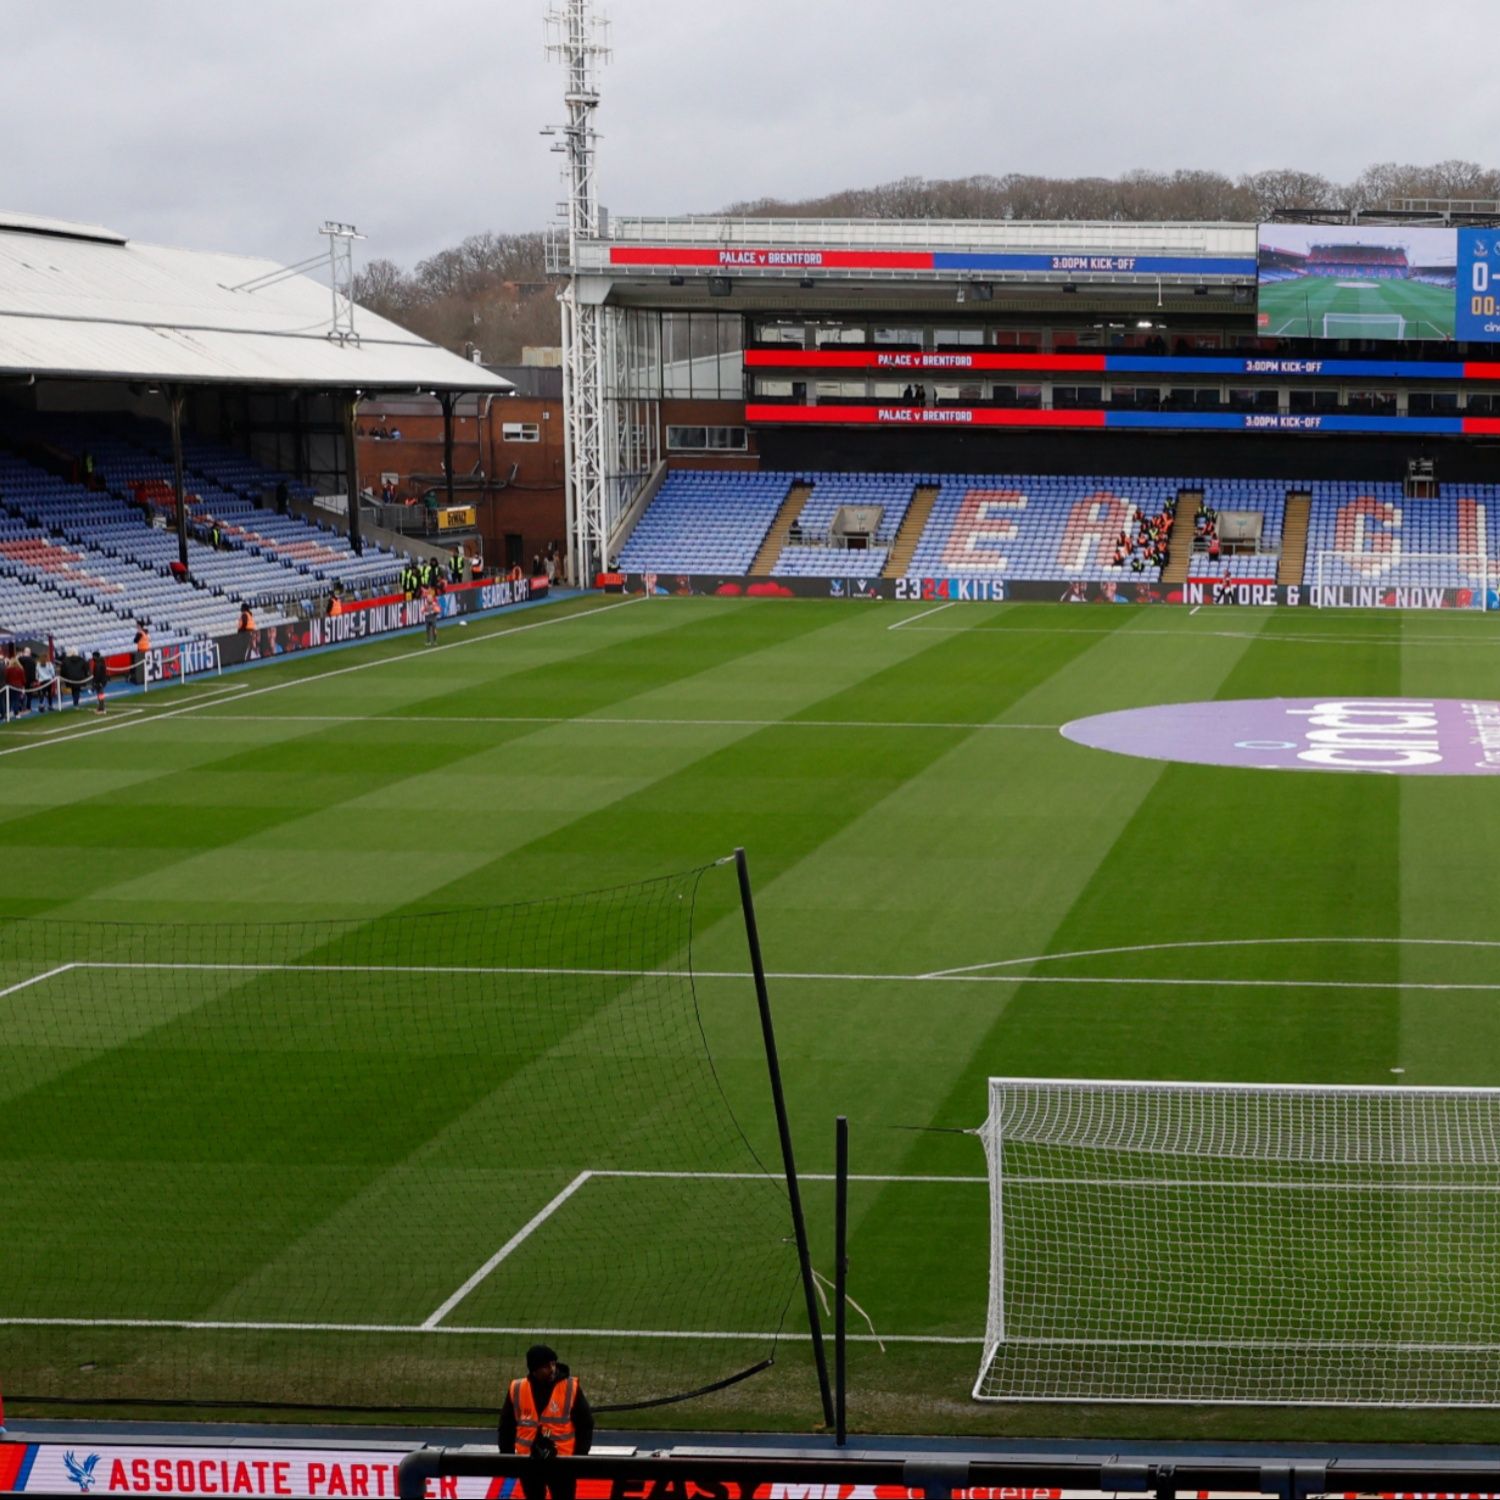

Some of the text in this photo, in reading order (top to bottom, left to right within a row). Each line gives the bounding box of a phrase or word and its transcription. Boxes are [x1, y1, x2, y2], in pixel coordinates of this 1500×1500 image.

[719, 252, 822, 265] PALACE v BRENTFORD
[1052, 257, 1136, 270] 3:00PM KICK-OFF
[878, 354, 973, 367] PALACE v BRENTFORD
[1246, 360, 1323, 373] 3:00PM KICK-OFF
[878, 409, 973, 421] PALACE v BRENTFORD
[1245, 416, 1322, 428] 3:00PM KICK-OFF
[957, 579, 1005, 600] KITS
[1182, 583, 1203, 605] IN
[1287, 585, 1301, 605] &
[1310, 586, 1387, 607] ONLINE
[1396, 587, 1446, 608] NOW
[309, 617, 321, 647] IN
[324, 611, 355, 643] STORE
[369, 604, 403, 634] ONLINE
[184, 639, 214, 674] KITS
[1286, 702, 1443, 767] cinch
[108, 1458, 292, 1495] ASSOCIATE
